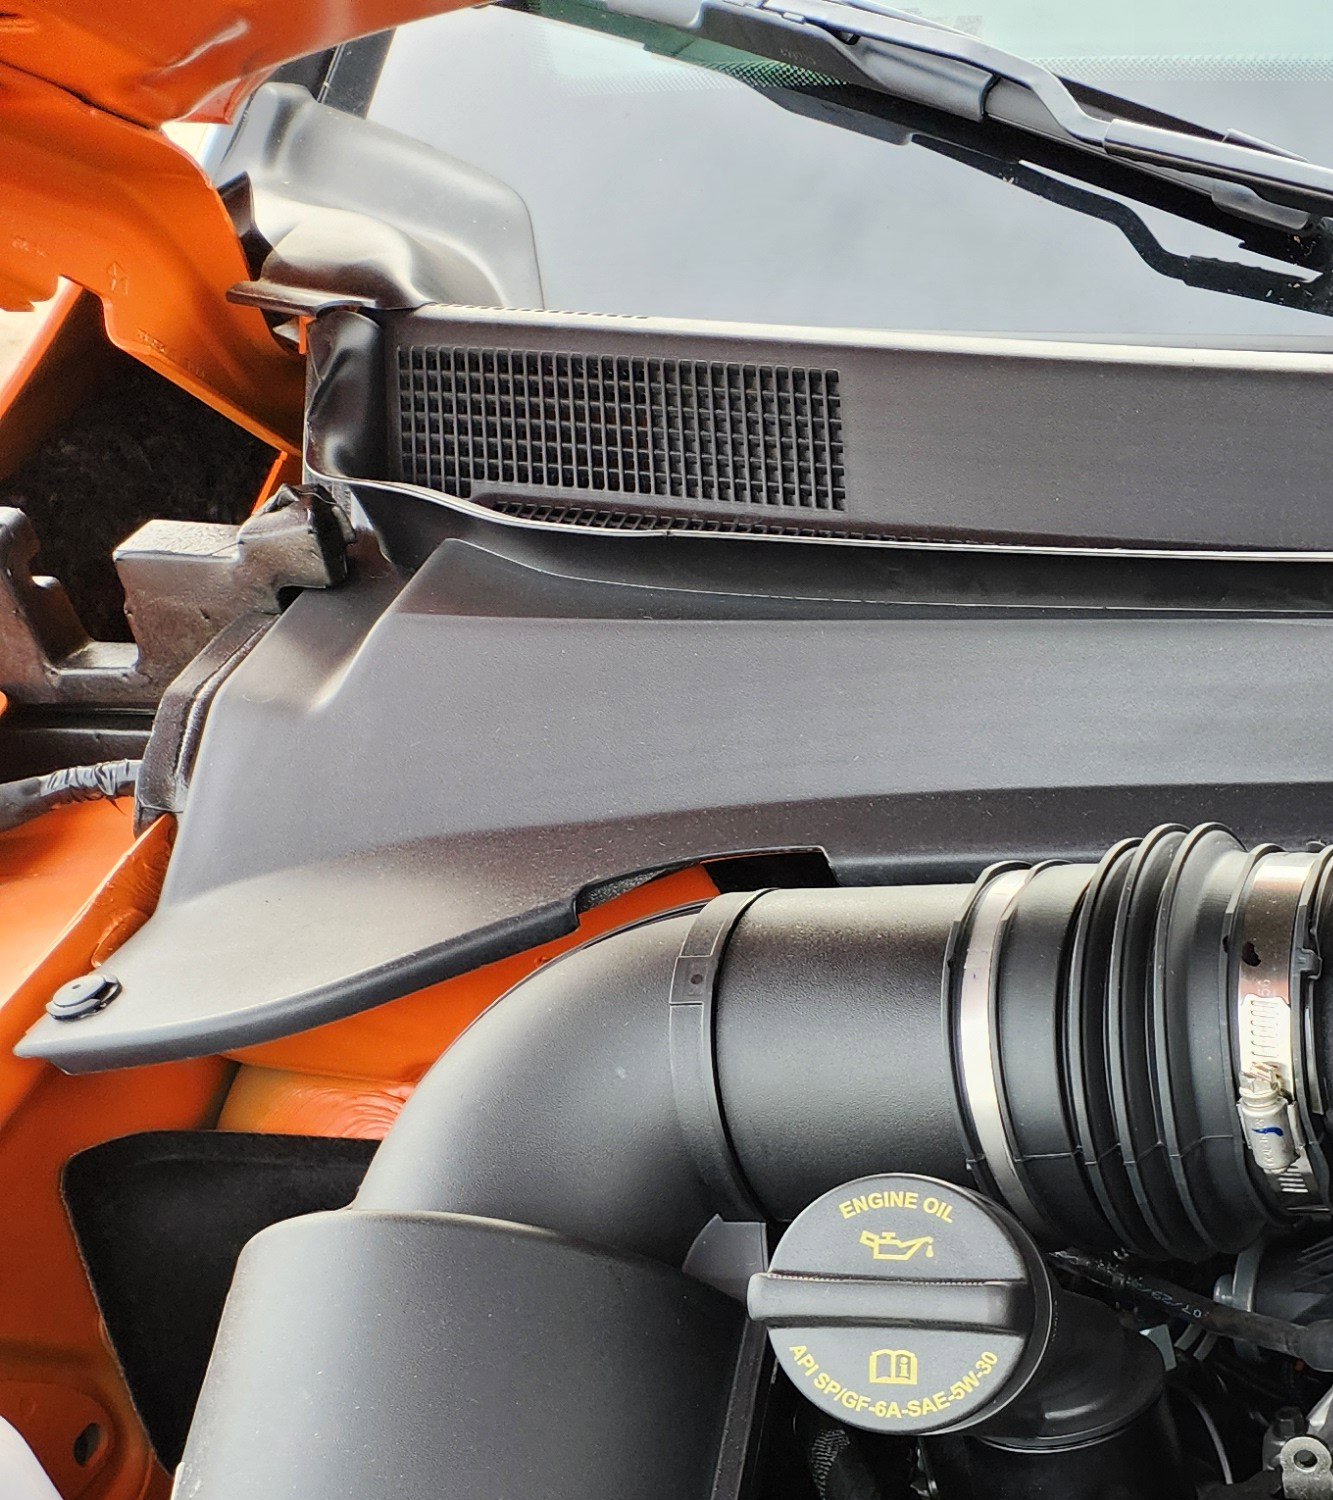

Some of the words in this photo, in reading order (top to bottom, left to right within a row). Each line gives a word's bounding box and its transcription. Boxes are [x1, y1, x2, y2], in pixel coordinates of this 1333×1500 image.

[839, 1191, 919, 1220] ENGINE
[924, 1197, 954, 1223] OIL
[790, 1344, 819, 1377] API
[813, 1351, 999, 1418] SP/GF-6A-SAE-5W-30
